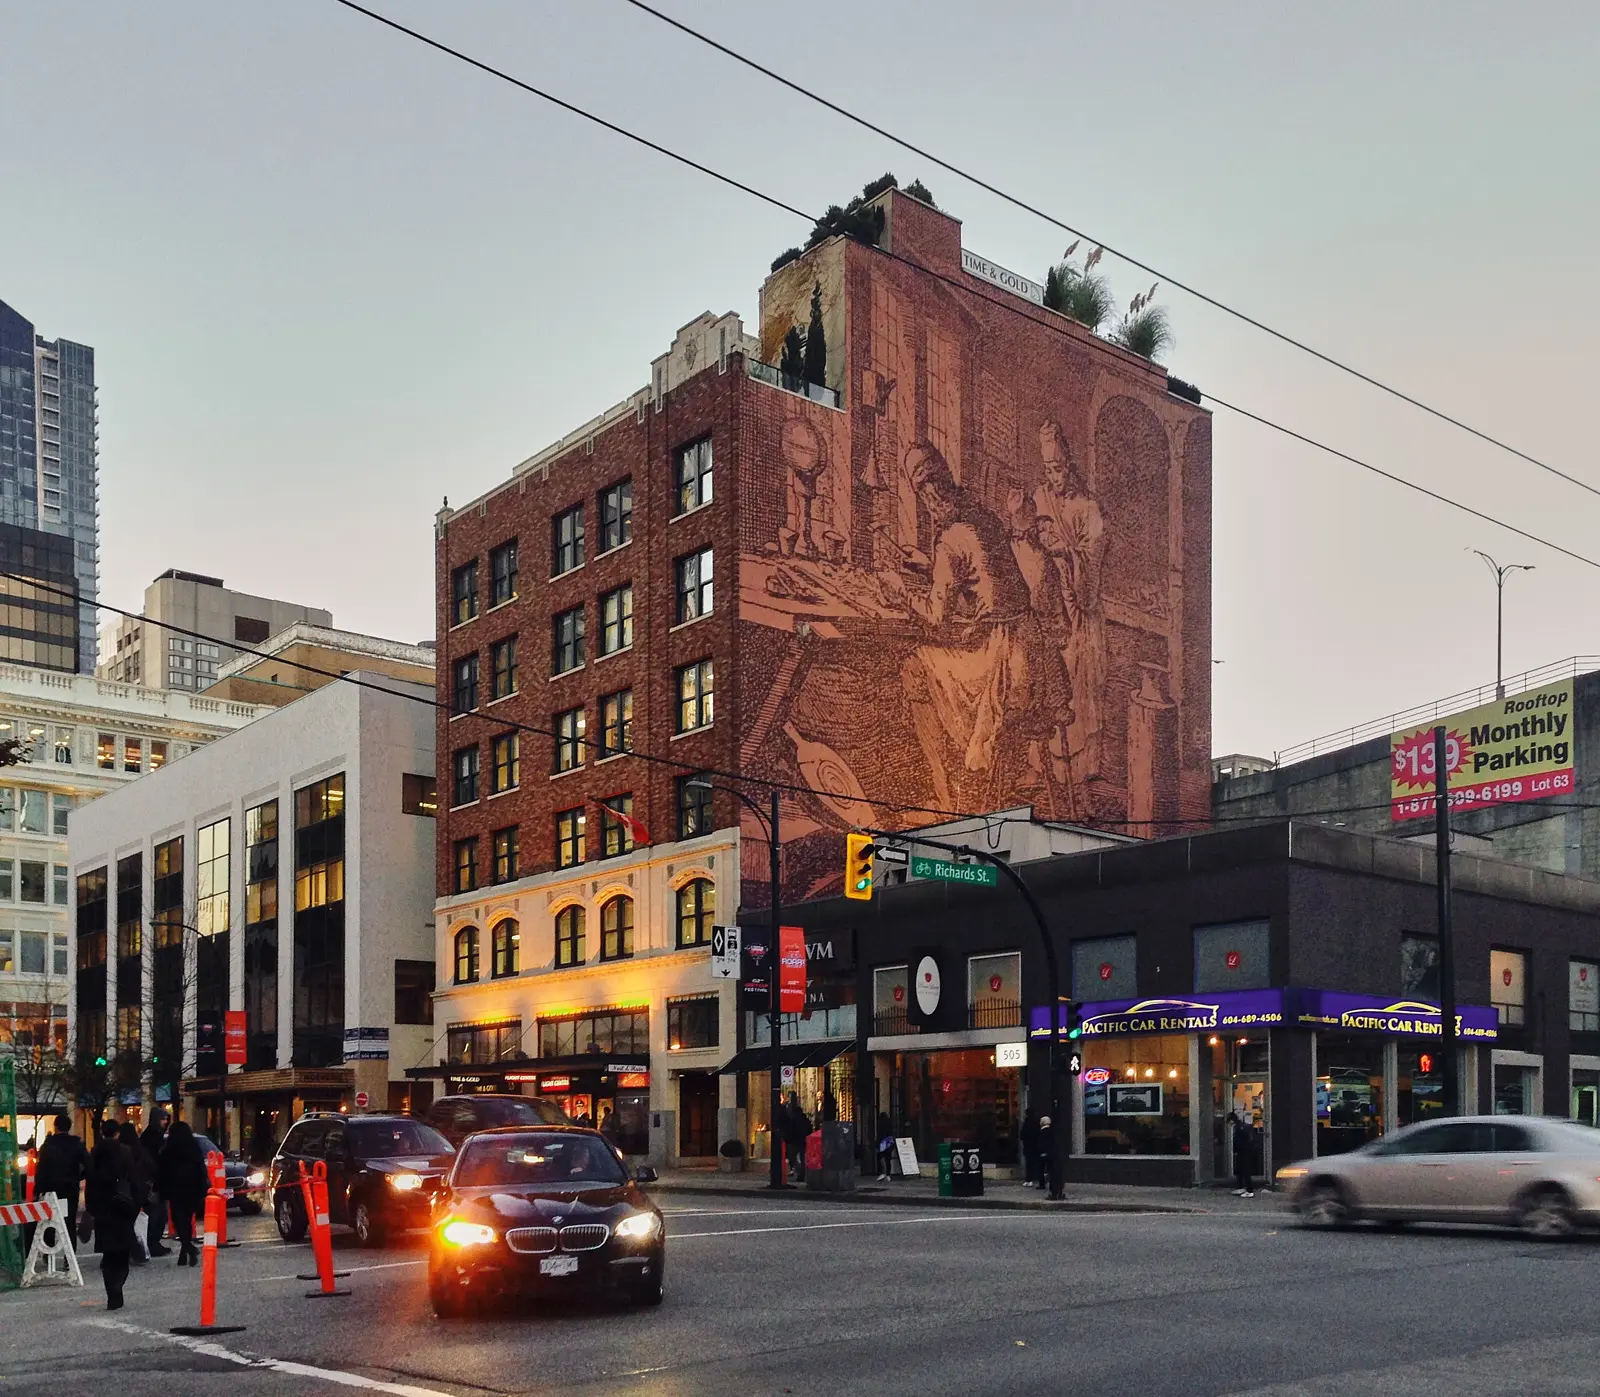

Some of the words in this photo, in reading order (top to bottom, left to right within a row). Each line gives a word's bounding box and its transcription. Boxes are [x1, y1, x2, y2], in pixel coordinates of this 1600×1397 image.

[964, 254, 987, 275] TIME
[990, 267, 996, 280] &
[1000, 272, 1028, 293] GOLD
[1504, 691, 1568, 714] Rooftop
[1470, 712, 1568, 746] Monthly
[1473, 741, 1568, 773] Parking
[1531, 779, 1550, 792] Lot
[1553, 775, 1569, 789] 63
[935, 863, 975, 881] Richards
[977, 868, 990, 883] St.
[1082, 1020, 1128, 1035] PACIFIC
[1130, 1018, 1156, 1031] CAR
[1160, 1014, 1218, 1030] RENTALS
[1222, 1012, 1282, 1026] 604-689-4506
[1341, 1013, 1386, 1031] PACIFIC
[1388, 1018, 1412, 1033] CAR
[1414, 1021, 1461, 1036] RENTS
[1003, 1049, 1021, 1061] 505
[1086, 1071, 1110, 1082] OPEN
